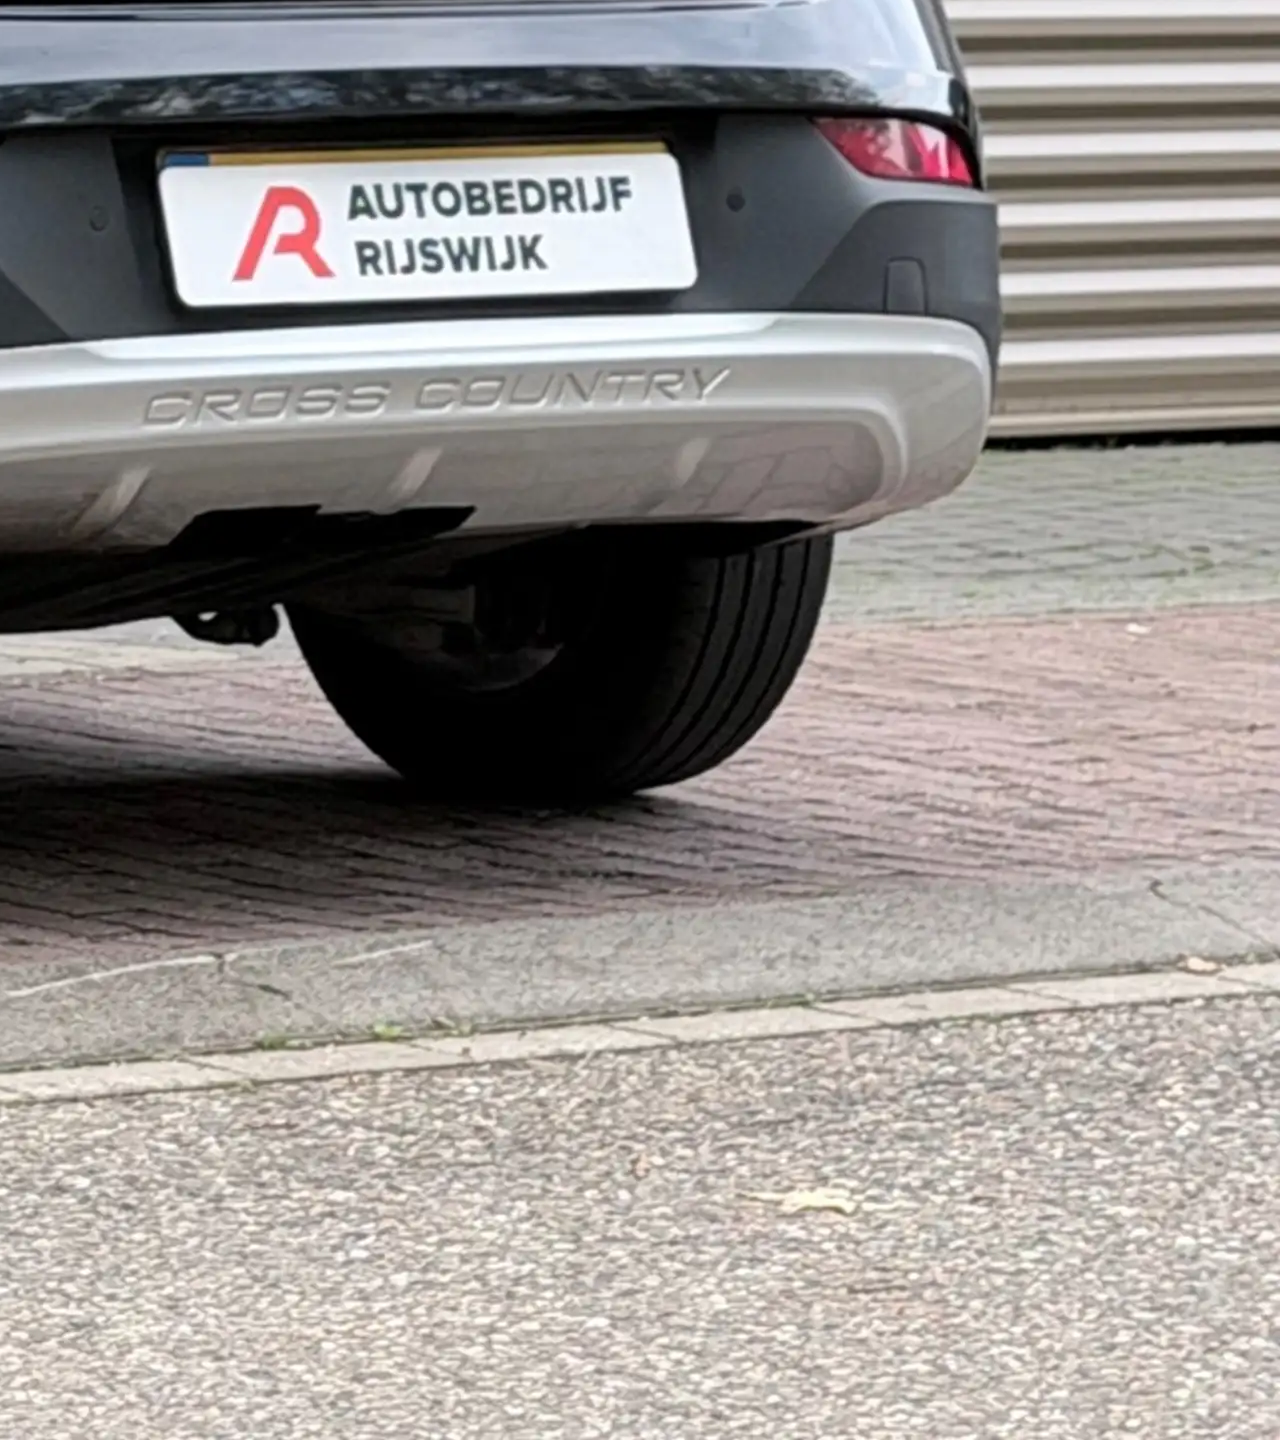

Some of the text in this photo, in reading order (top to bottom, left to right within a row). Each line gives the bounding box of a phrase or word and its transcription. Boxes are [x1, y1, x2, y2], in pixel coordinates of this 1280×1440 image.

[347, 175, 632, 221] AUTOBEDRIJF
[354, 233, 547, 277] RIJSWIJK
[143, 365, 730, 429] CROSS COUNTRY
